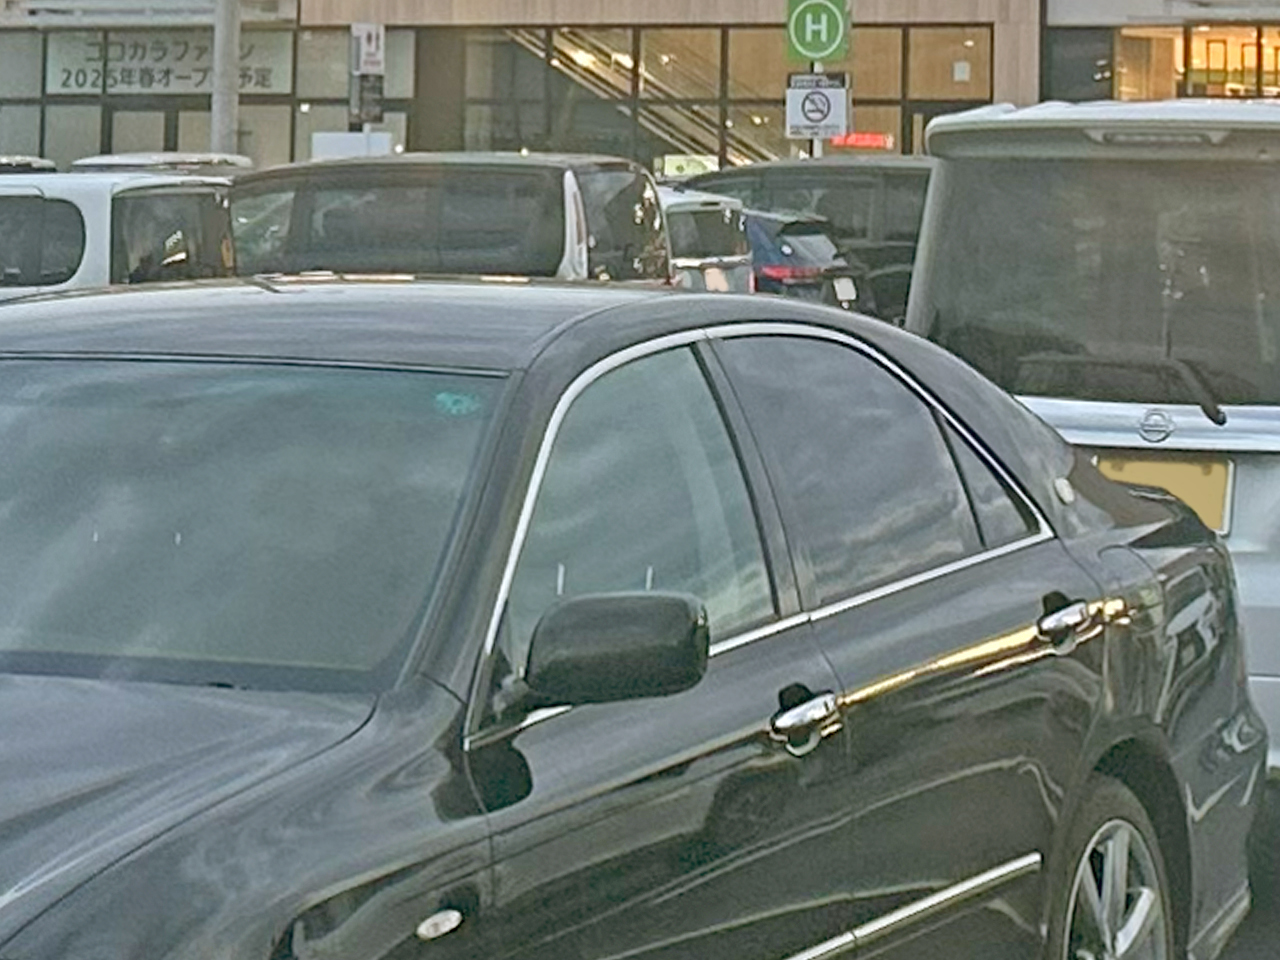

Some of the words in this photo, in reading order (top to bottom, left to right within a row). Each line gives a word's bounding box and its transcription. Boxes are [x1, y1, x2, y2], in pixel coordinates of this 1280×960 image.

[805, 12, 828, 42] H
[85, 41, 255, 63] ココカラファン
[60, 67, 273, 89] 2025年春オープ予定
